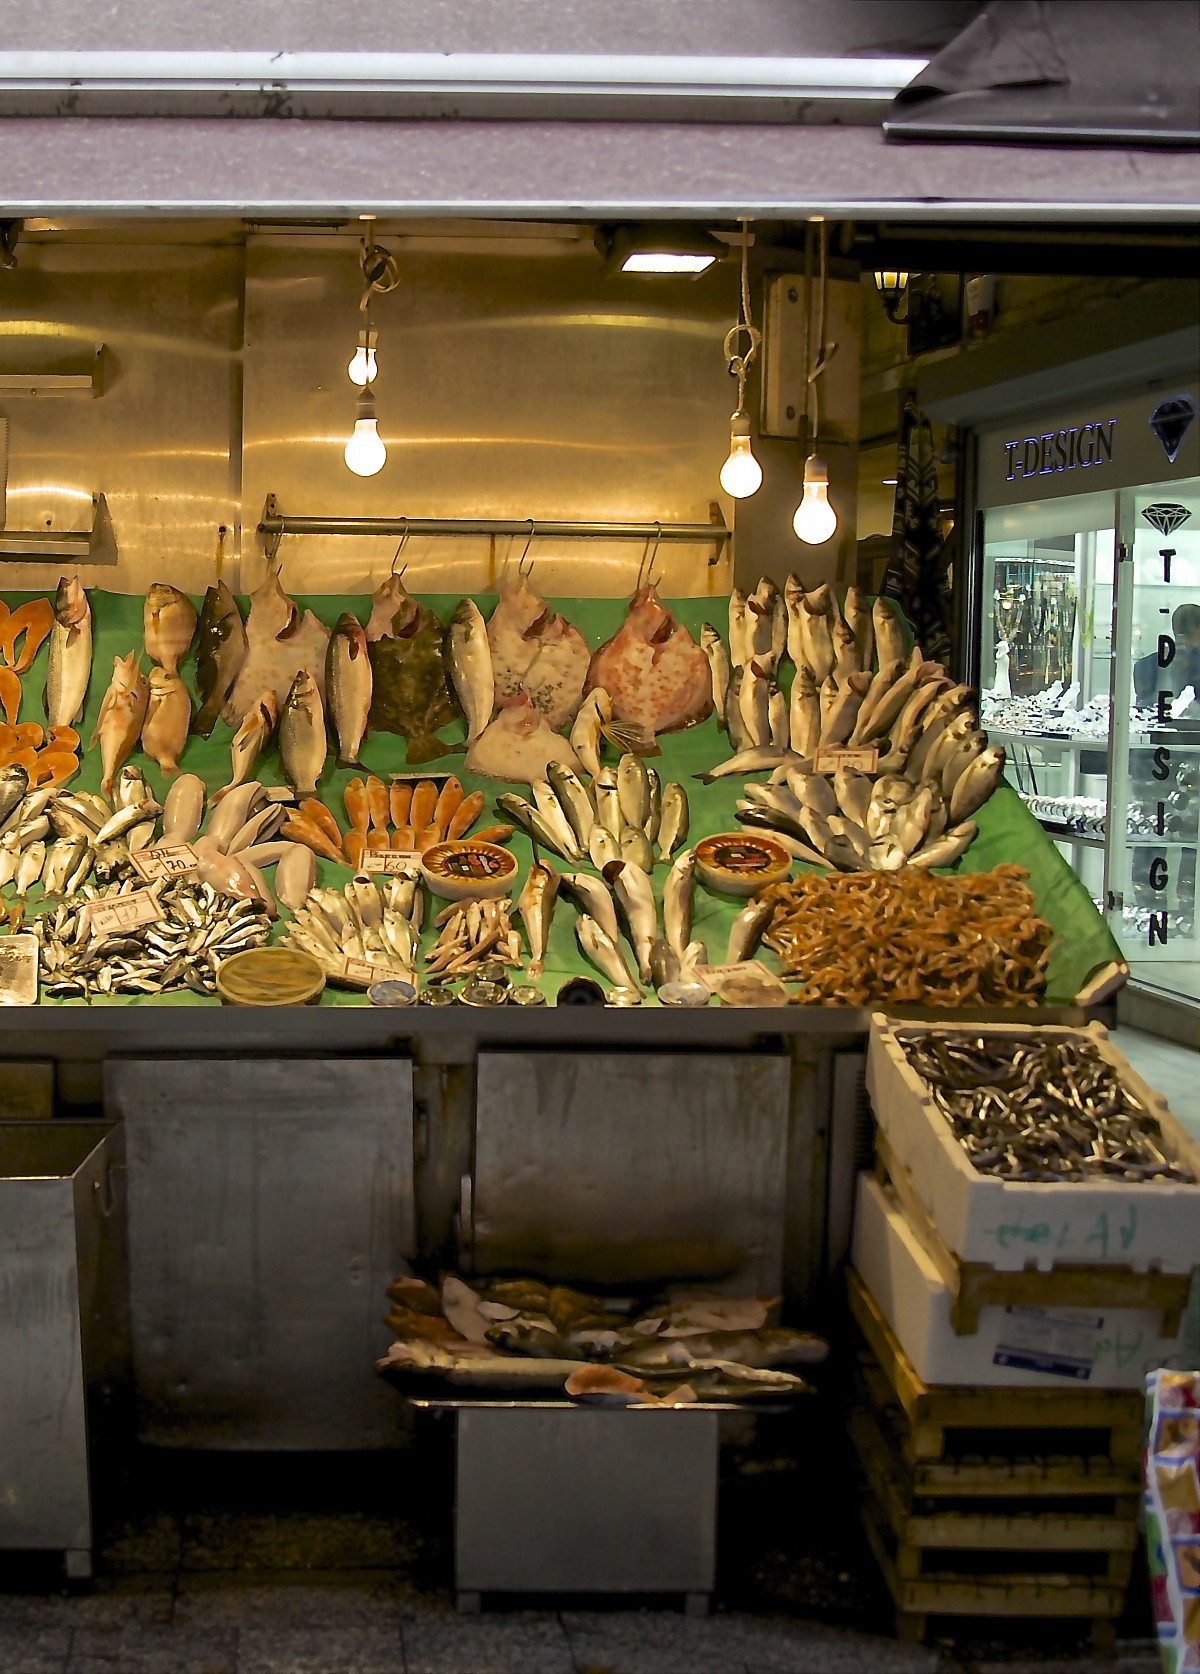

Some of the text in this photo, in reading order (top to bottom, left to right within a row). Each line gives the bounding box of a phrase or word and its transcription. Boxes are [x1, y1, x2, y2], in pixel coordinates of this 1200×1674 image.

[1004, 418, 1118, 482] T-DESIGN
[1148, 549, 1177, 946] T-DESIGN
[385, 861, 407, 872] 60
